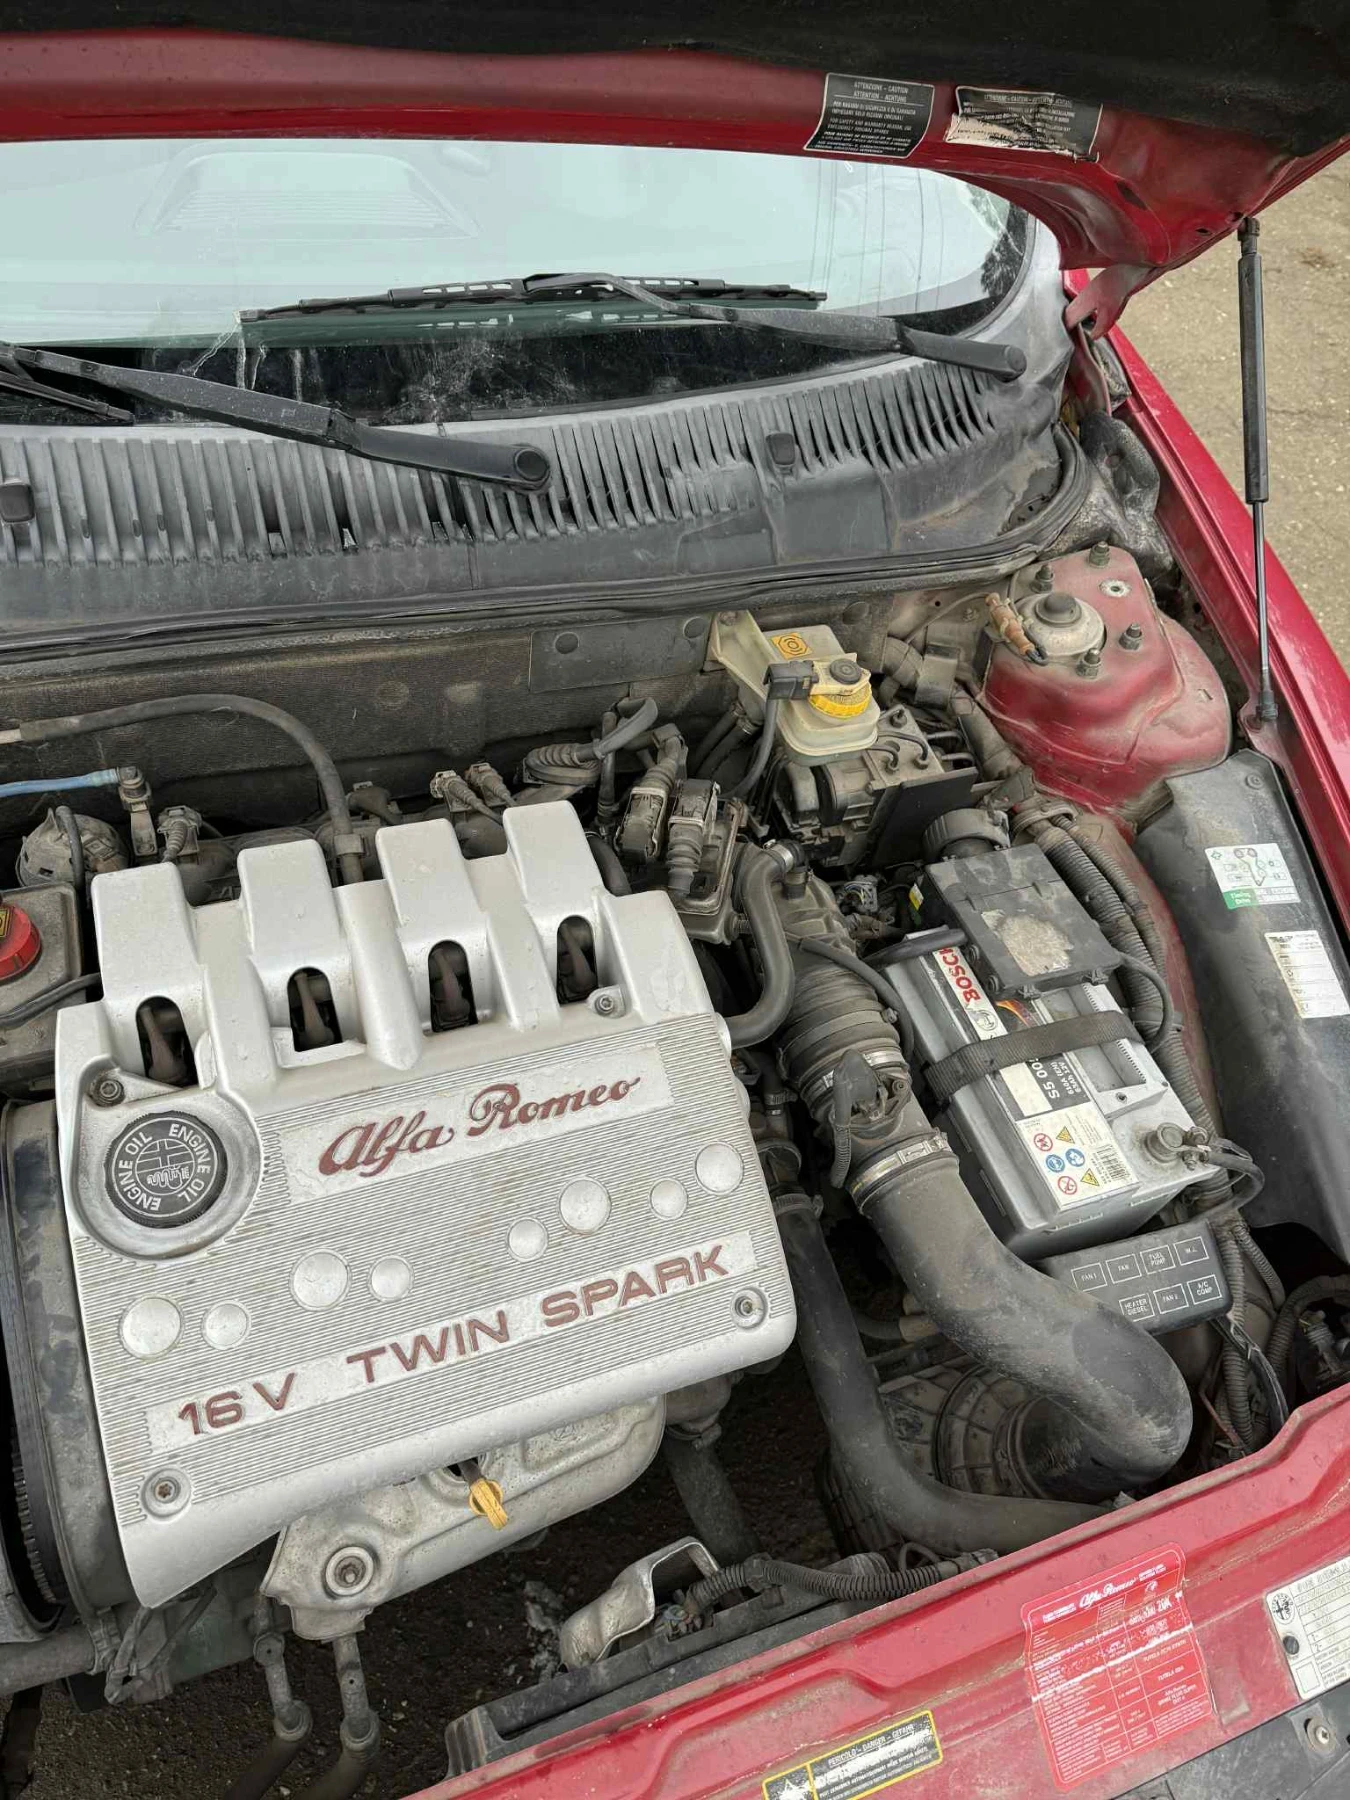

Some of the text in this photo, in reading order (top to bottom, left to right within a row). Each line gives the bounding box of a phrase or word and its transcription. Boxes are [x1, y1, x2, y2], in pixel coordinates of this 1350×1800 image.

[1043, 1081, 1061, 1099] S5
[318, 1076, 641, 1177] Alfa Romeo
[118, 1131, 161, 1211] ENGINE OIL
[168, 1123, 212, 1202] ENGINE OIL
[346, 1309, 512, 1384] TWIN
[540, 1244, 730, 1328] SPARK
[1124, 1299, 1147, 1308] HEATER
[1127, 1305, 1148, 1316] DIESEL
[1079, 1590, 1102, 1609] Alfa
[1103, 1577, 1137, 1597] Romeo
[827, 1724, 915, 1766] PERICOLO DANGER GEFAHR
